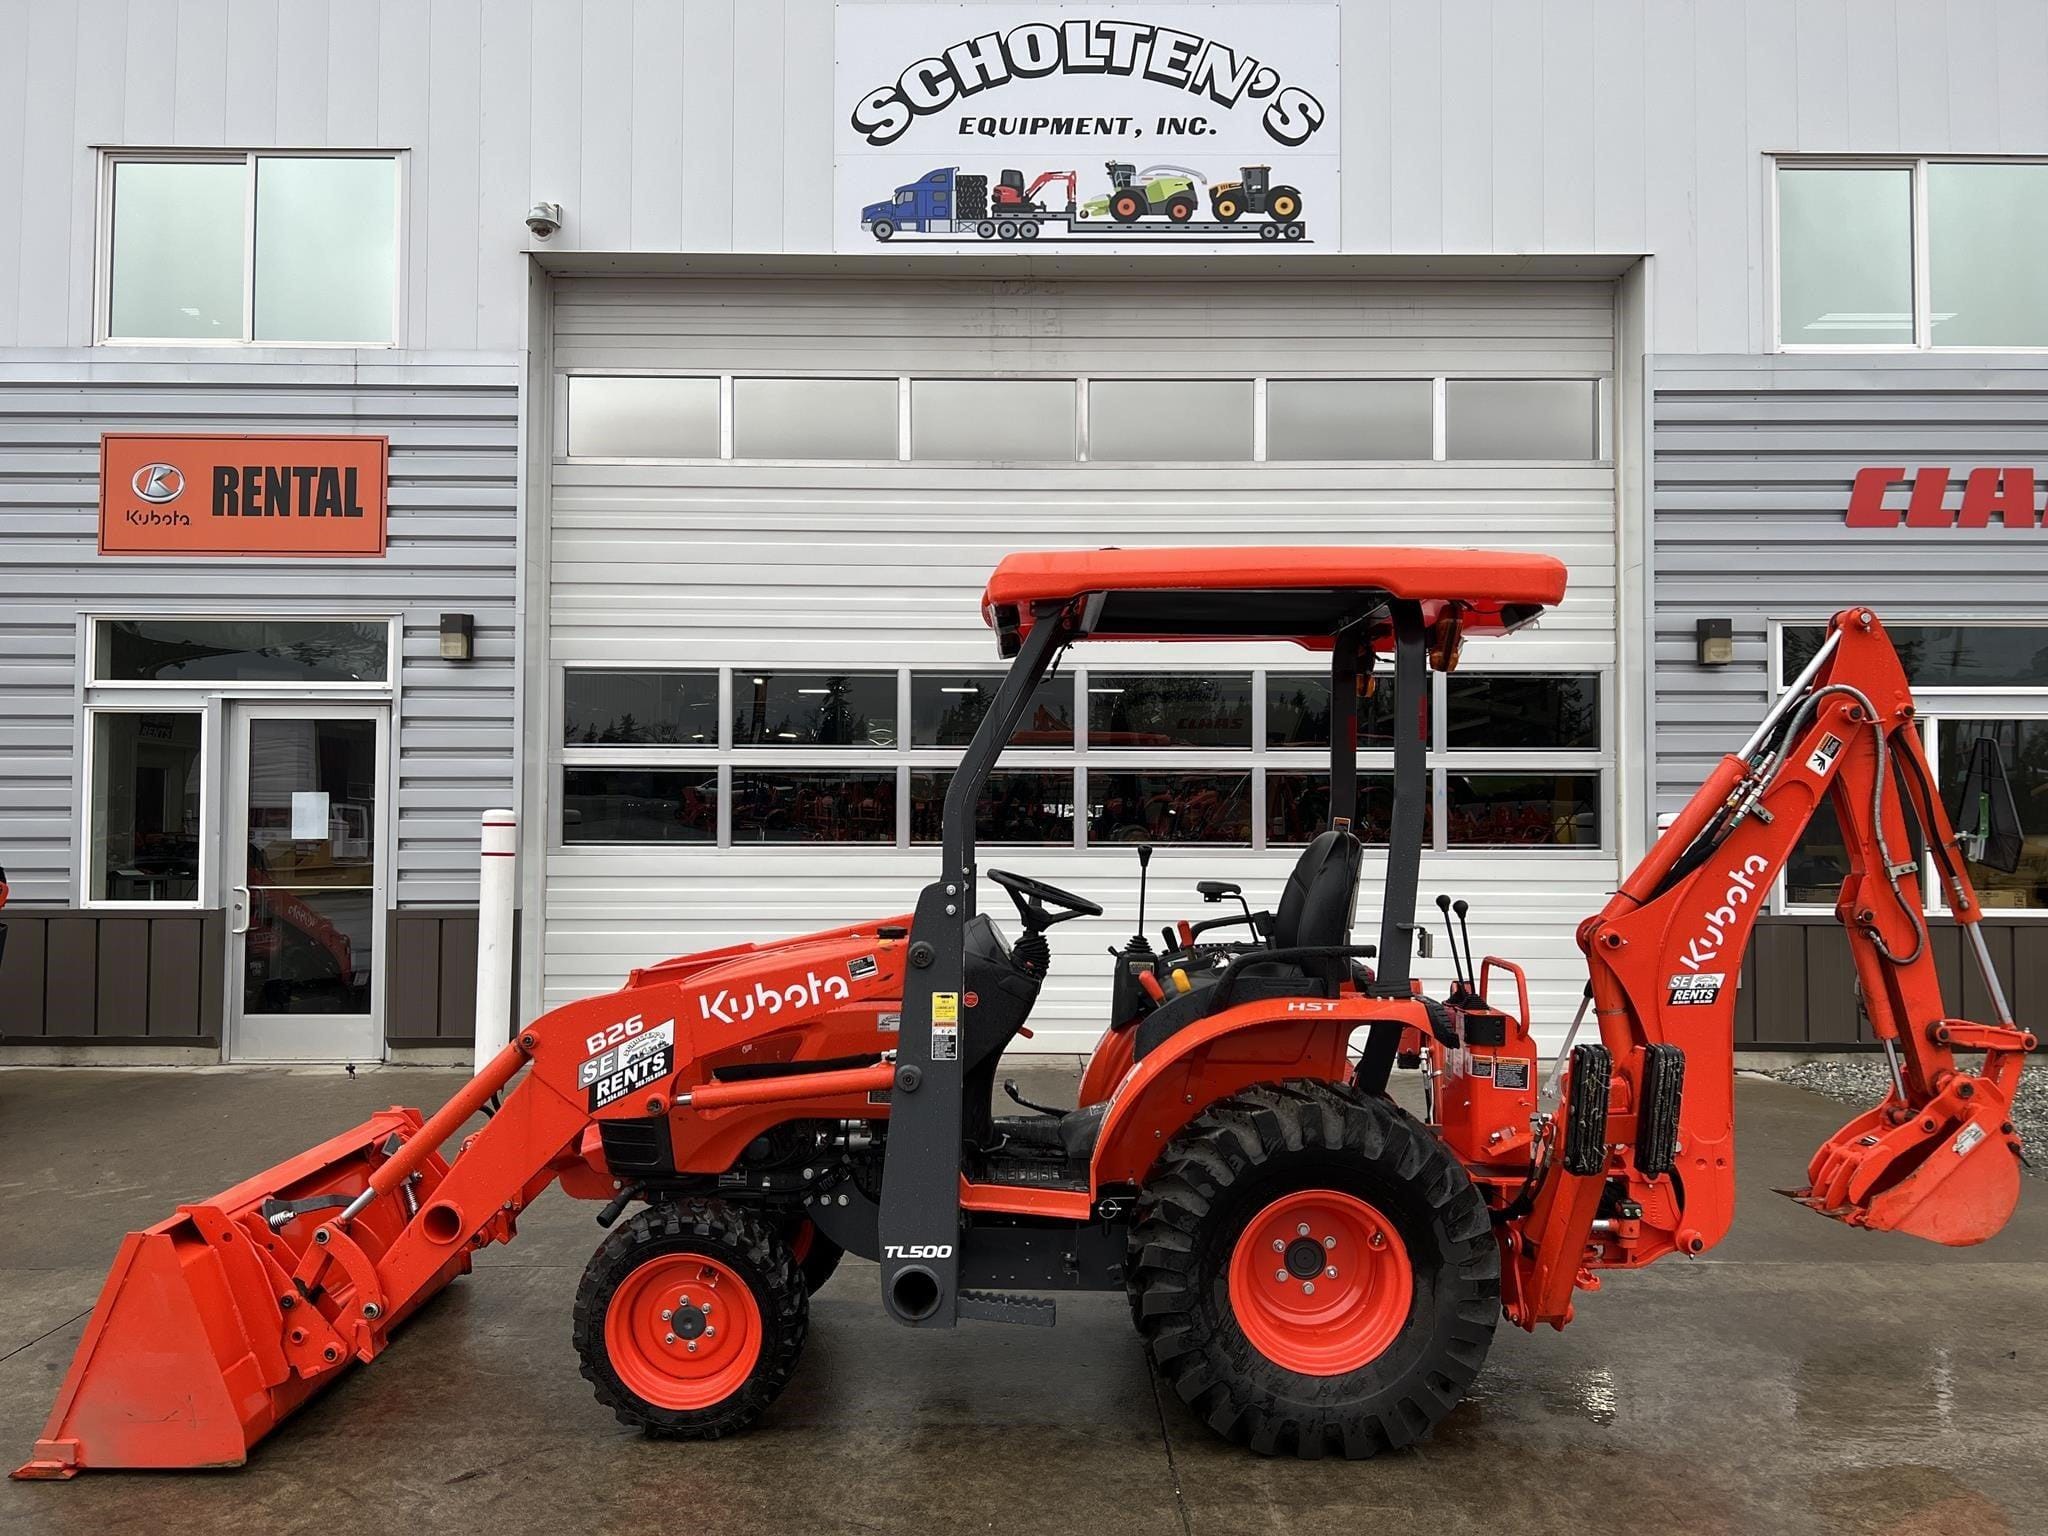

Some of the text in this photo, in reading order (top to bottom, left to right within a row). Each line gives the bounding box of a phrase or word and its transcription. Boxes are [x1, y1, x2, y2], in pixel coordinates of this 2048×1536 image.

[851, 20, 1325, 146] SCHOLTEN'S
[959, 116, 1218, 138] EQUIPMENT, INC.
[212, 466, 364, 518] RENTAL
[1845, 468, 2048, 528] CLA
[126, 509, 191, 526] Kubota
[1680, 854, 1769, 971] Kubota
[700, 971, 851, 1024] Kubota
[1671, 976, 1691, 988] SE
[1673, 989, 1715, 1001] RENTS
[1287, 1002, 1339, 1012] HST
[586, 1013, 644, 1056] B26
[582, 1052, 614, 1084] SE
[596, 1052, 666, 1101] RENTS
[884, 1245, 953, 1259] TL500
